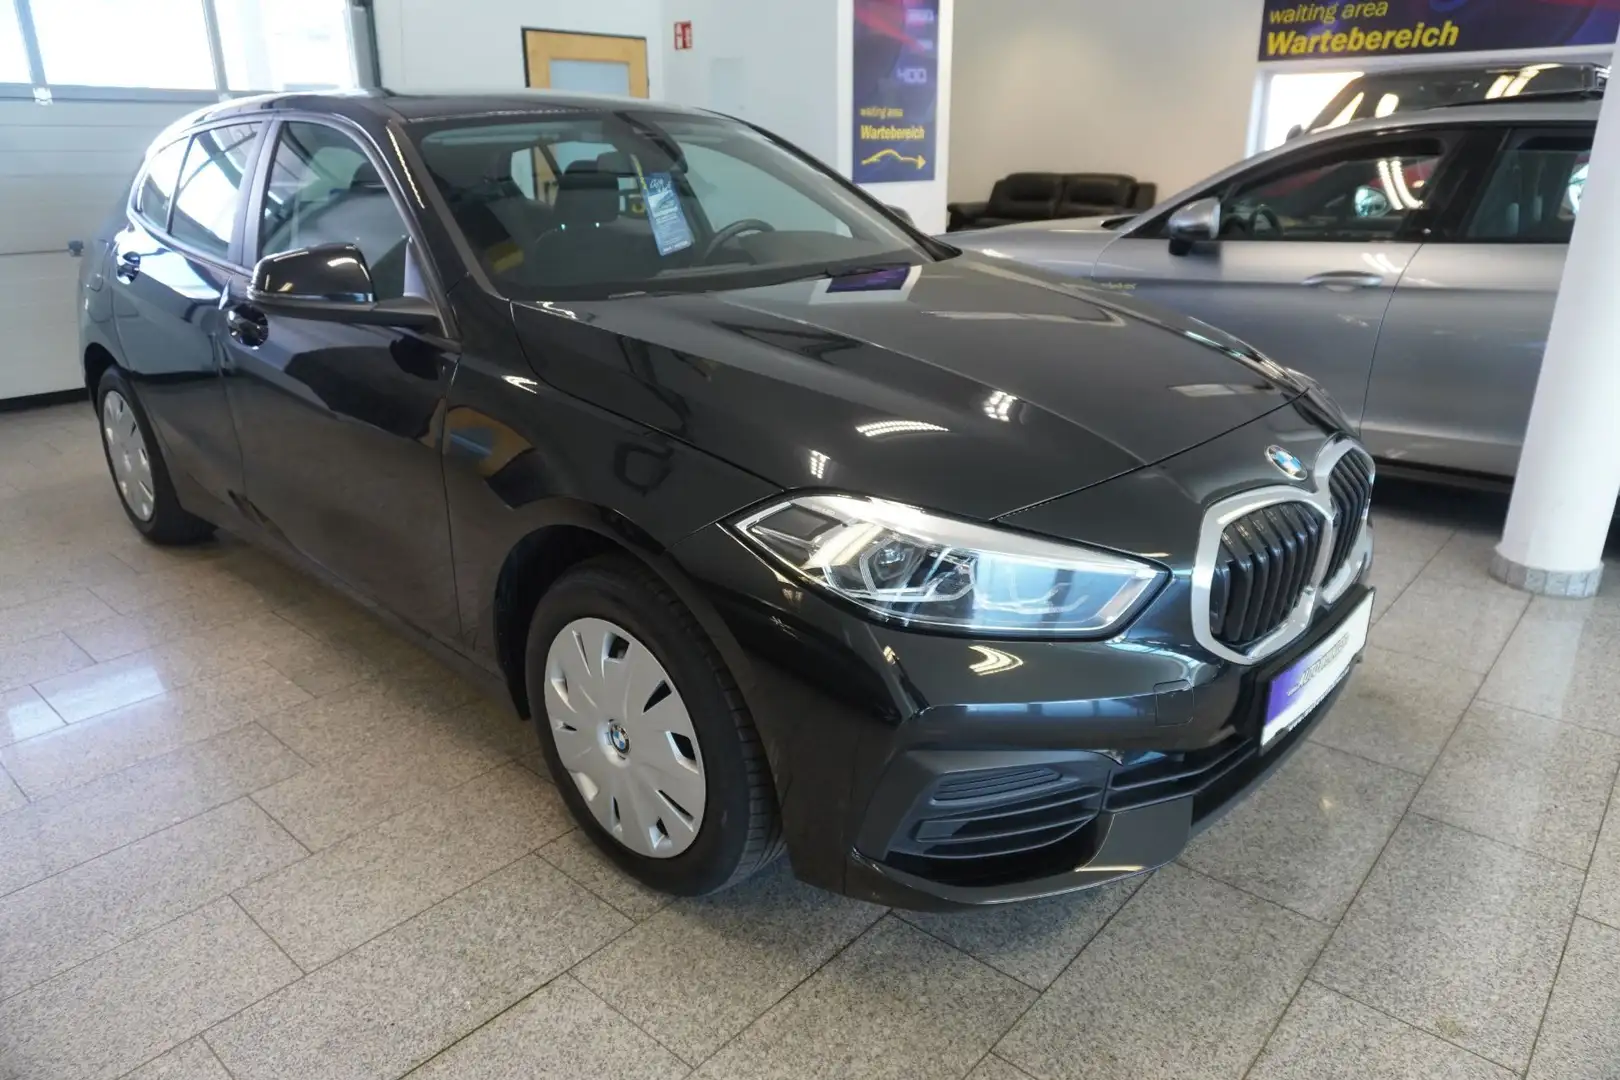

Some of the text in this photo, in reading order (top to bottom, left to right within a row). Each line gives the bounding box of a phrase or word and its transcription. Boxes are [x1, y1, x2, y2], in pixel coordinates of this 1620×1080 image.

[1268, 0, 1389, 25] waiting area
[1266, 20, 1460, 56] Wartebereich
[860, 124, 925, 140] Wartebereich
